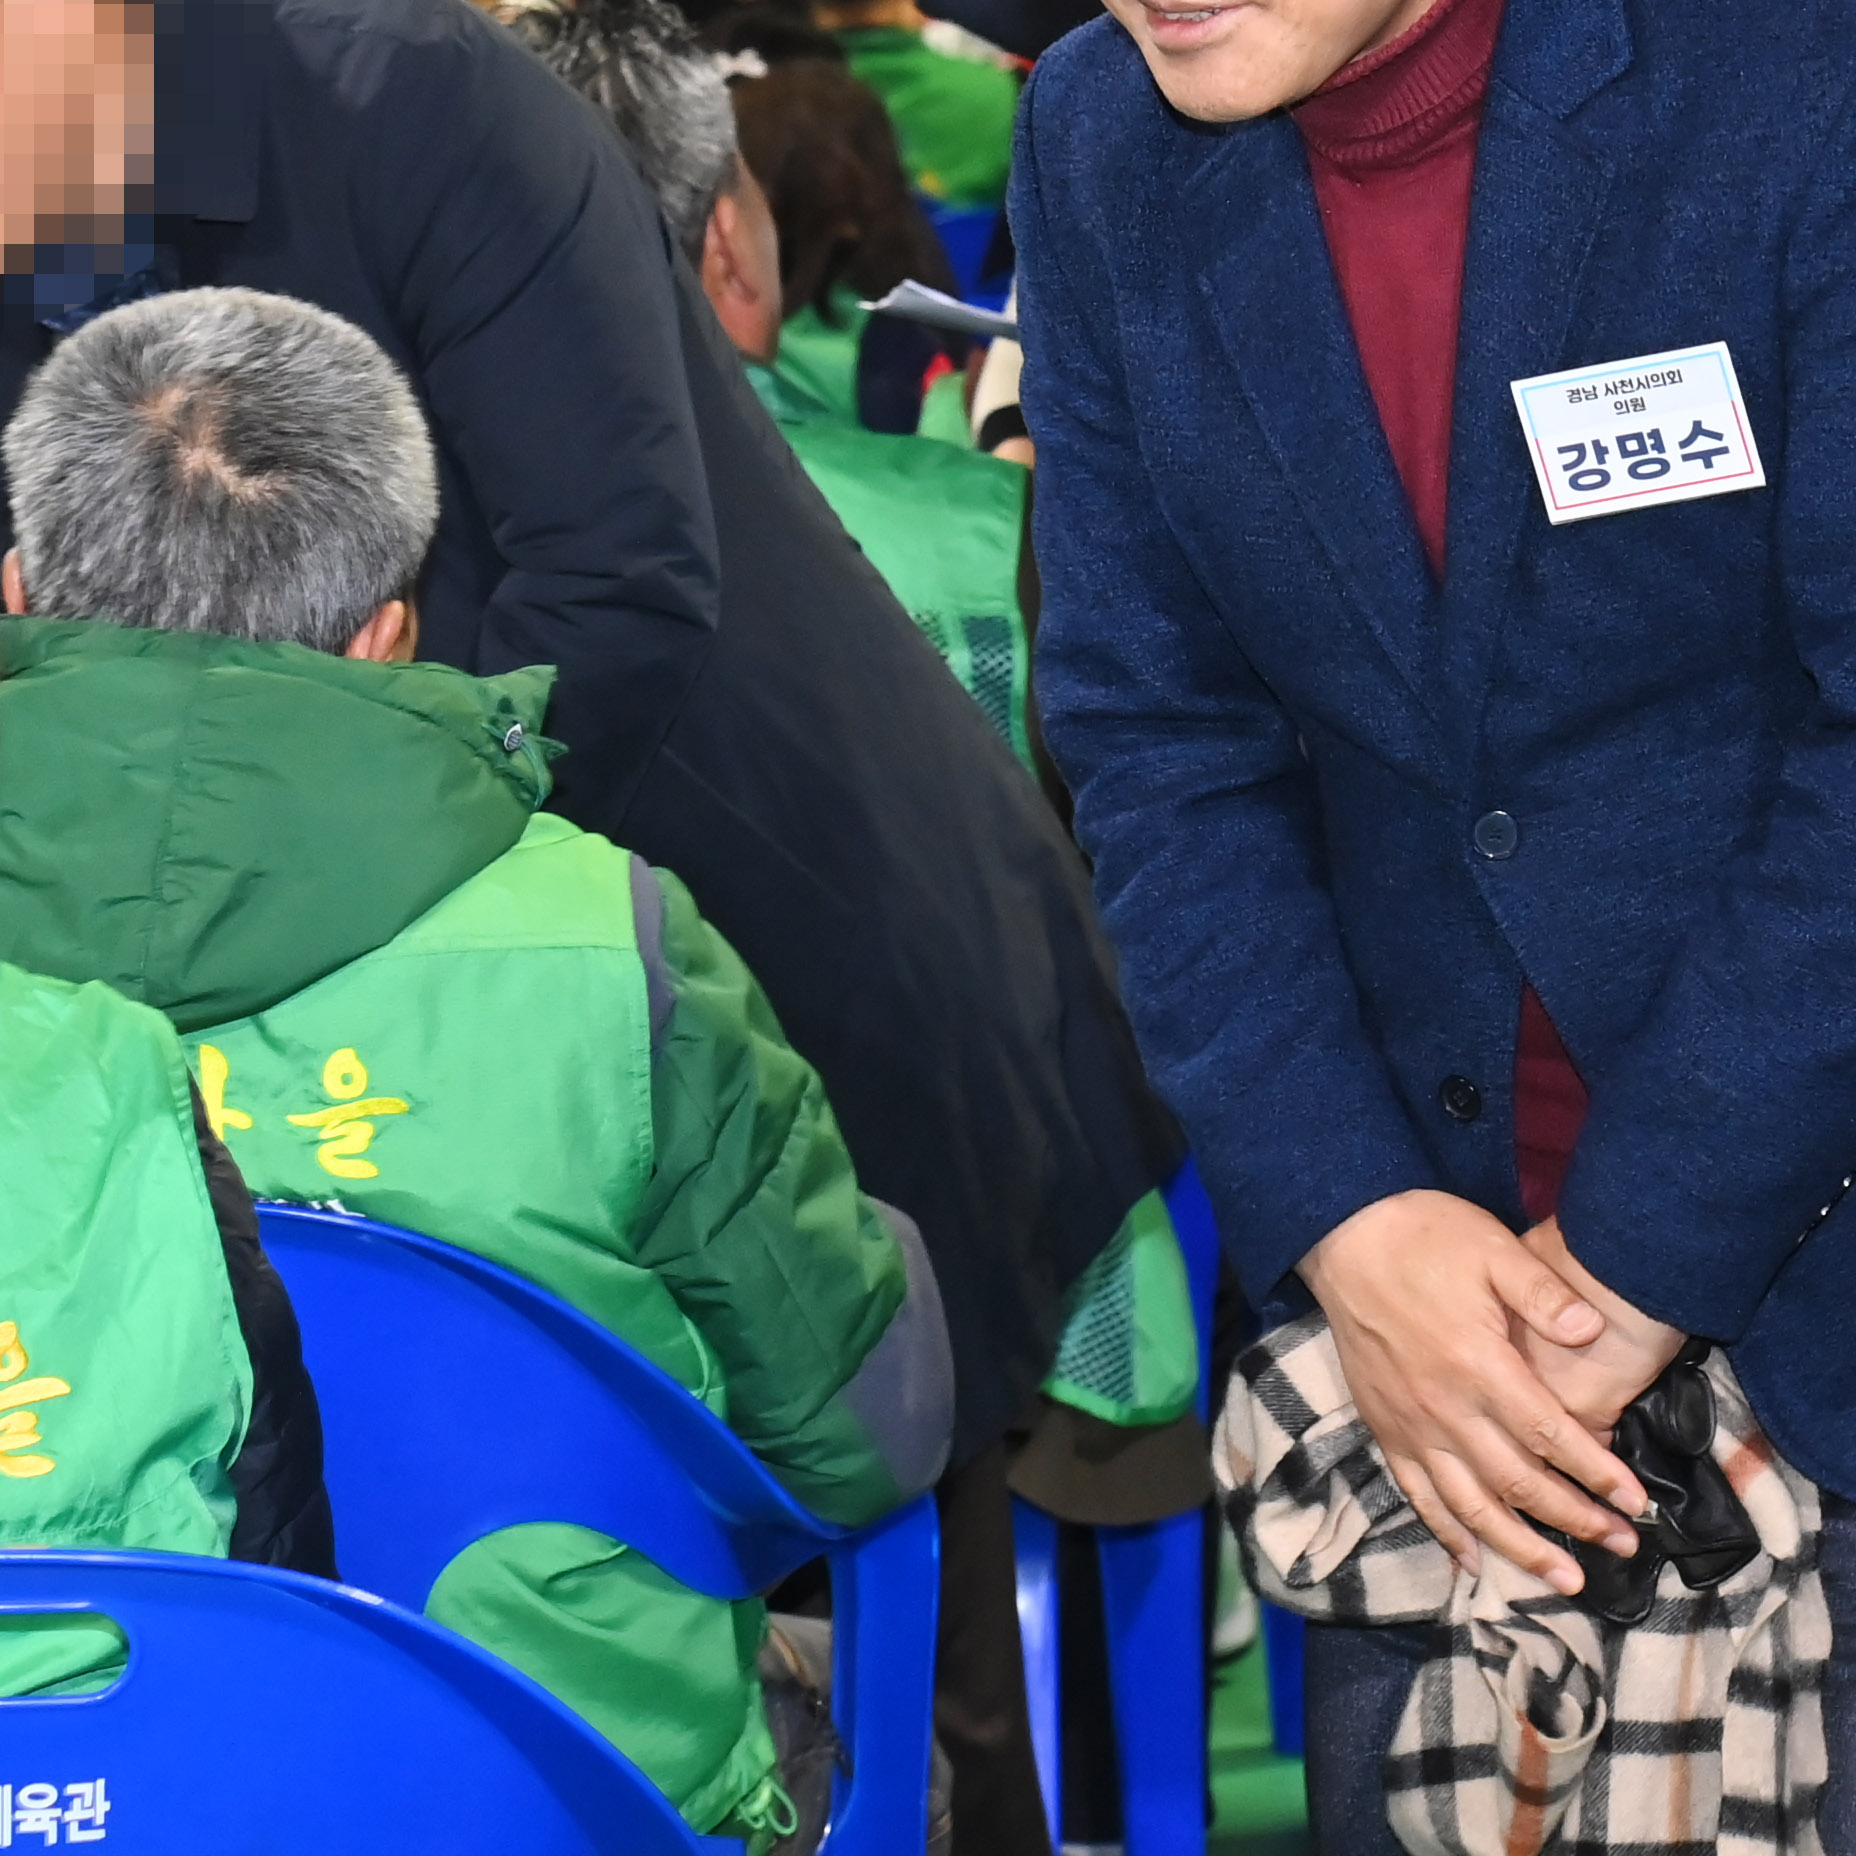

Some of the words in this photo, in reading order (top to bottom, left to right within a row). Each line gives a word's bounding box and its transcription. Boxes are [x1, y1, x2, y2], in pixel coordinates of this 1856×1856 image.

[1566, 385, 1599, 405] 경남
[1603, 368, 1684, 397] 사천시의회
[1613, 396, 1647, 416] 의원
[1556, 419, 1731, 493] 강명수
